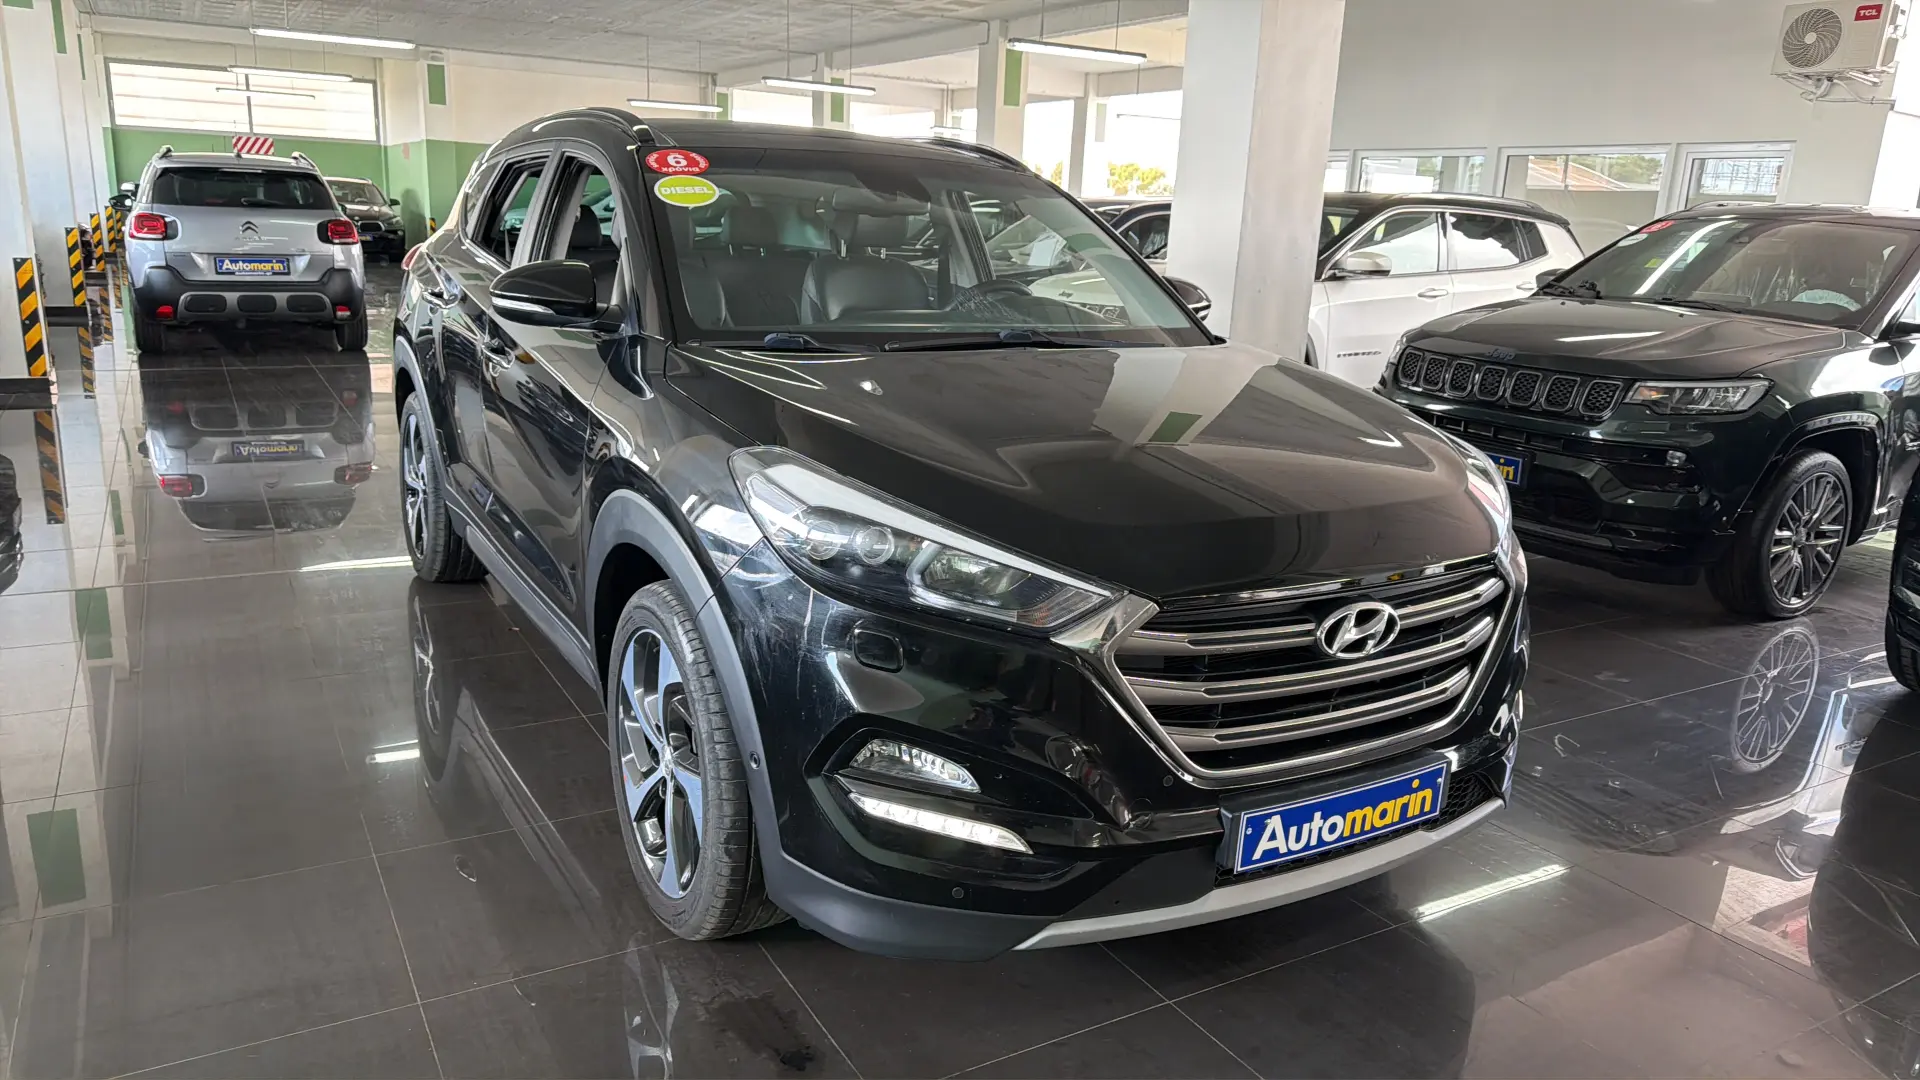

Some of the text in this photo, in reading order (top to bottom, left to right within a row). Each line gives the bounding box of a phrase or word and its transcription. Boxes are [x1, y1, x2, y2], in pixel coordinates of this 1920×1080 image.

[1858, 8, 1879, 17] TCL
[666, 154, 688, 168] 6
[660, 186, 715, 195] DIESEL
[221, 258, 284, 271] Automarin
[1251, 778, 1433, 861] Automarin
